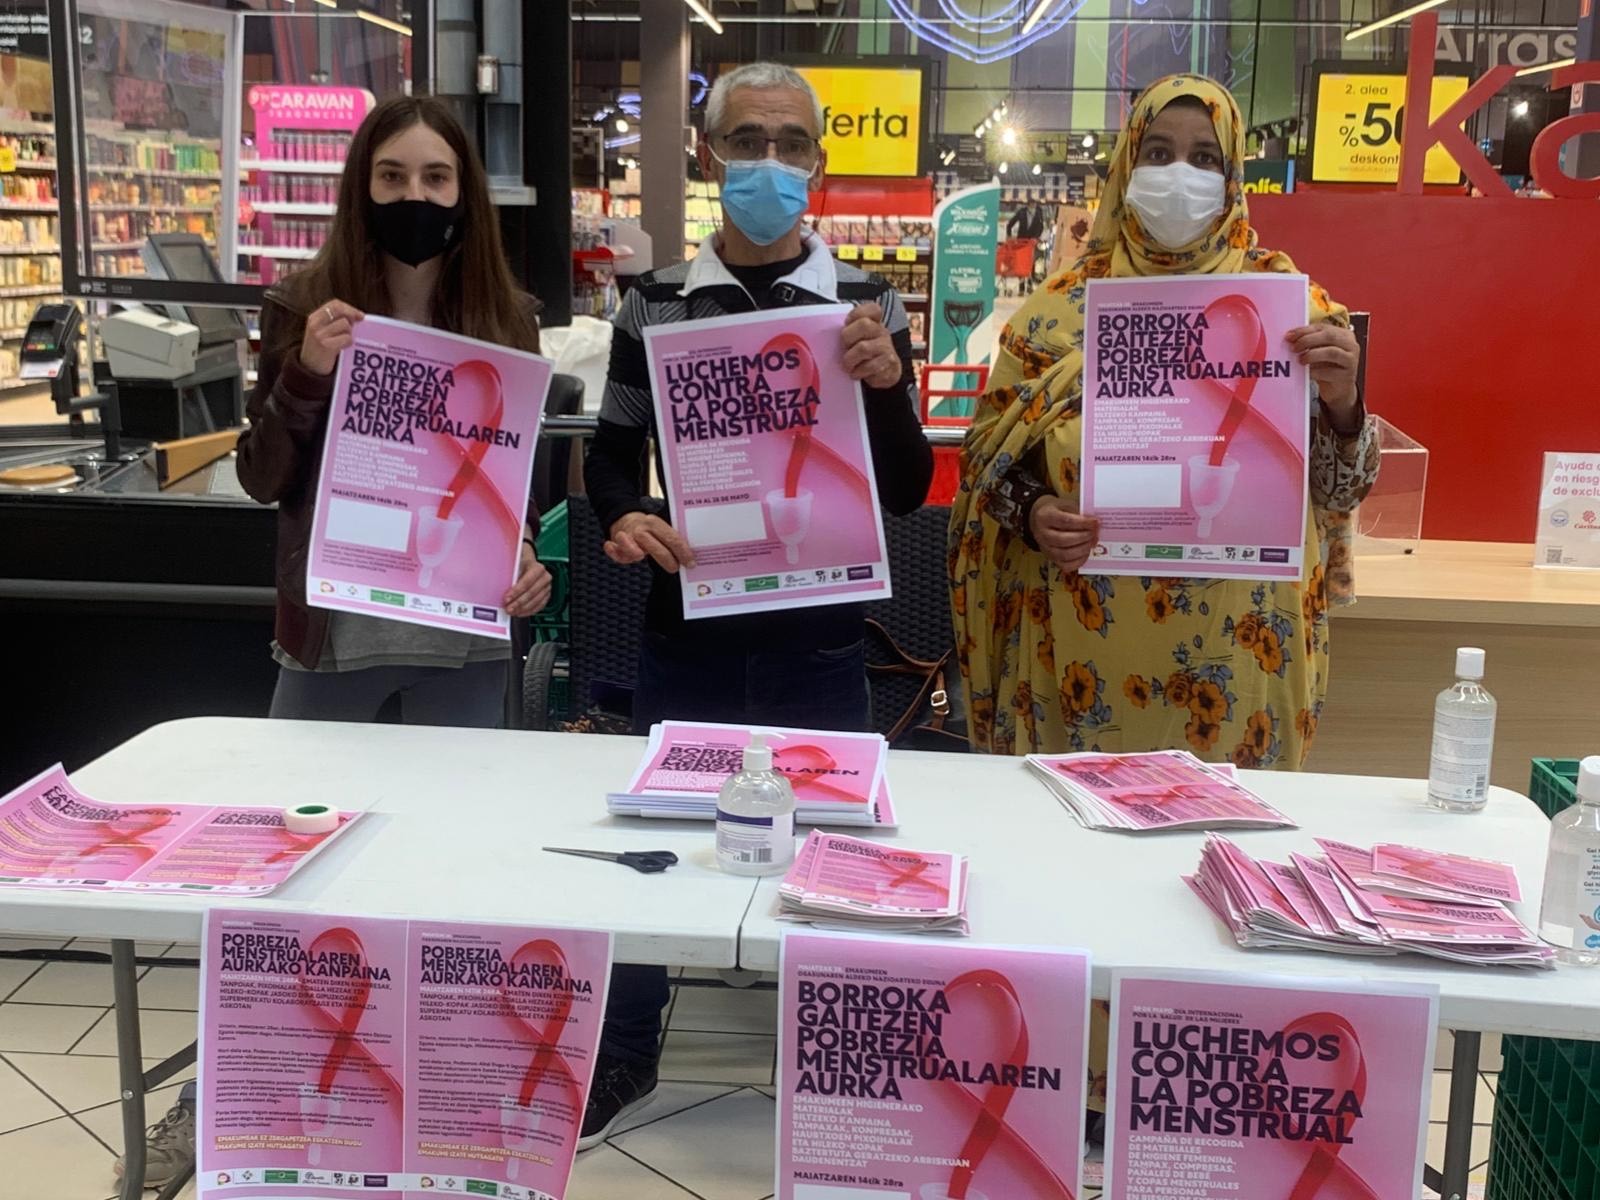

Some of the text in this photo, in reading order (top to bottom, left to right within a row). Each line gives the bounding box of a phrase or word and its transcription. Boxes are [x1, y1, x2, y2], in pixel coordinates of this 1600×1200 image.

[1360, 84, 1388, 95] alea
[270, 92, 354, 109] CARAVAN
[823, 106, 908, 138] ferta
[1350, 153, 1400, 165] deskont
[1099, 313, 1209, 331] BORROKA
[1097, 330, 1203, 348] GAITEZEN
[1097, 347, 1206, 366] POBREZIA
[353, 350, 455, 387] BORROKA
[666, 349, 801, 384] LUCHEMOS
[1097, 361, 1290, 382] MENSTRUALAREN
[351, 368, 448, 400] GAITEZEN
[669, 374, 771, 404] CONTRA
[1096, 381, 1174, 398] AURKA
[349, 383, 447, 418] POBREZIA
[672, 386, 821, 423] LA POBREZA
[341, 417, 415, 445] AURKA
[345, 401, 520, 448] MENSTRUALAREN
[675, 406, 819, 443] MENSTRUAL
[1556, 462, 1593, 471] Ayuda
[1554, 475, 1569, 483] en
[1553, 487, 1568, 496] de
[222, 934, 300, 950] POBREZIA
[221, 947, 360, 967] MENSTRUALAREN
[422, 945, 502, 961] POBREZIA
[221, 960, 391, 981] AURKAKO KANPAINA
[421, 959, 563, 978] MENSTRUALAREN
[420, 971, 592, 994] AURKAKO KANPAINA
[798, 980, 951, 1014] BORROKA
[797, 1003, 942, 1036] GAITEZEN
[797, 1026, 946, 1059] POBREZIA
[1133, 1021, 1340, 1062] LUCHEMOS
[796, 1048, 1061, 1090] MENSTRUALAREN
[1131, 1050, 1289, 1085] CONTRA
[795, 1071, 903, 1100] AURKA
[793, 1095, 923, 1112] EMAKUMEEN HIGIENERAKO
[1131, 1077, 1363, 1118] LA POBREZA
[793, 1104, 853, 1116] MATERIALAK
[793, 1113, 891, 1127] BILTZEKO KANPAINA
[1130, 1104, 1354, 1144] MENSTRUAL
[793, 1139, 884, 1152] ETA HILEKO-KOPAK
[1129, 1135, 1178, 1144] CAMPAÑA
[1195, 1138, 1244, 1148] RECOGIDA
[1129, 1143, 1201, 1153] DE MATERIALES
[792, 1147, 970, 1167] BAZTERTUTA GERATZEKO ARRISKUAN
[792, 1155, 868, 1168] DAUDENENTZAT
[1143, 1153, 1181, 1161] HIGIENE
[1183, 1154, 1236, 1165] FEMENINA,
[793, 1171, 904, 1187] MAIATZAREN 14tik 28ra
[1128, 1168, 1170, 1178] PAÑALES
[1173, 1171, 1184, 1179] DE
[1127, 1185, 1207, 1197] PARA PERSONAS
[1136, 1178, 1168, 1186] COPAS
[1170, 1180, 1240, 1190] MENSTRUALES
